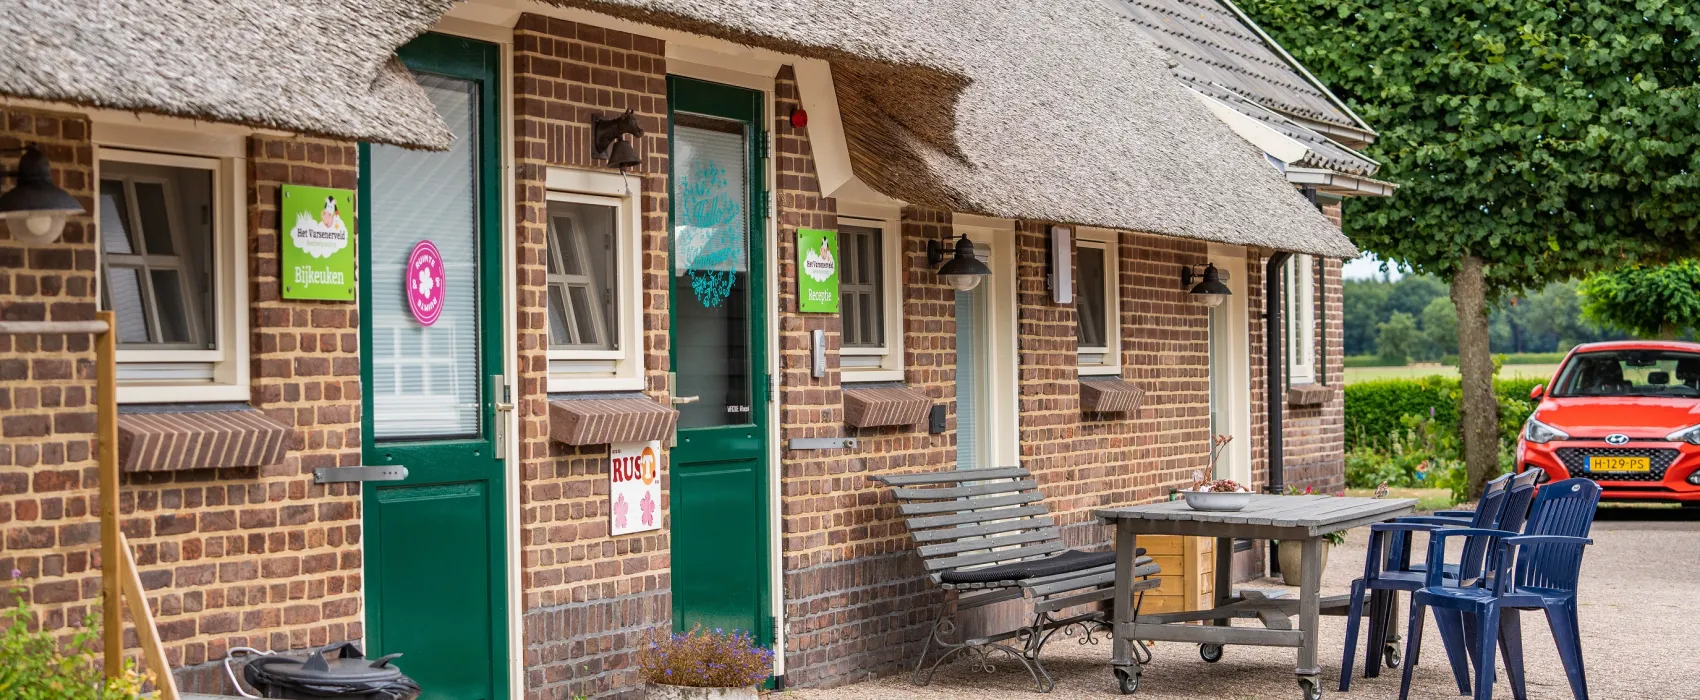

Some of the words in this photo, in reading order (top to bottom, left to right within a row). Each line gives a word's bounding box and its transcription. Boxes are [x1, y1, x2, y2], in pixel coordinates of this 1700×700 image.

[297, 228, 308, 238] Het
[294, 265, 345, 288] Bijkeuken
[808, 288, 832, 304] Receptie
[1594, 459, 1644, 469] H-129-PS
